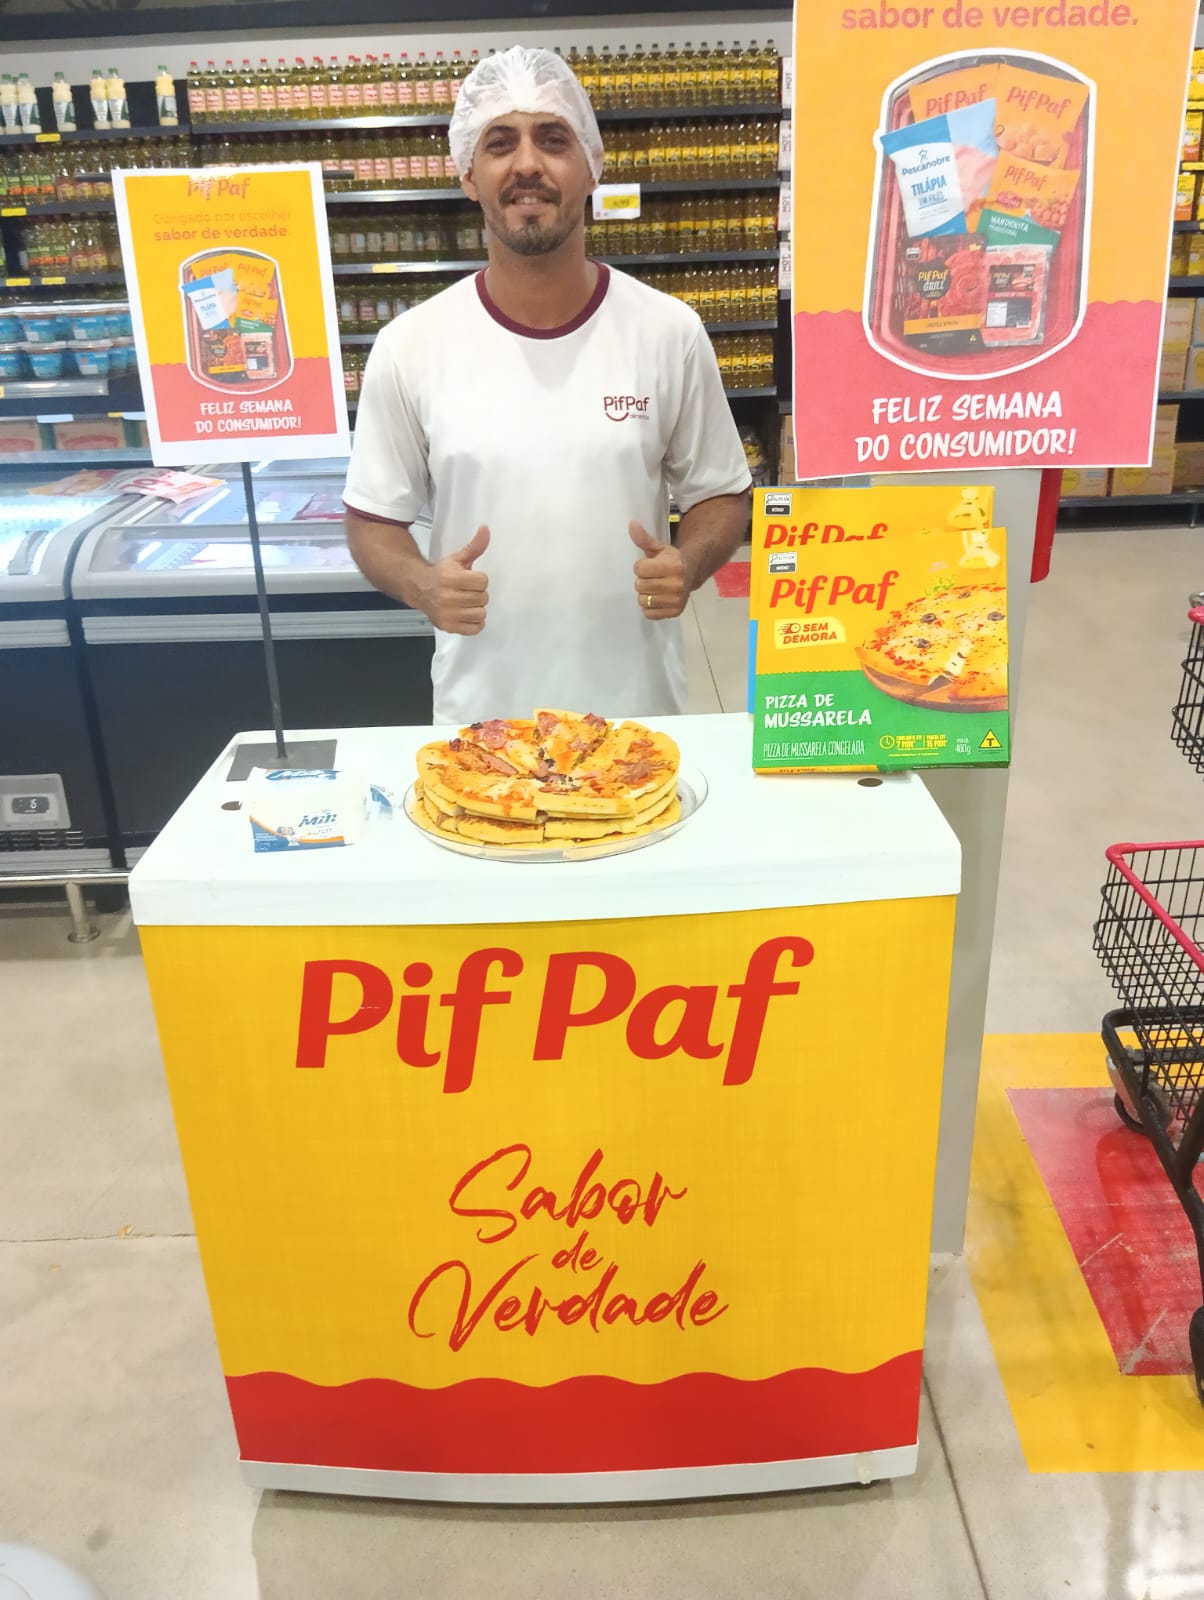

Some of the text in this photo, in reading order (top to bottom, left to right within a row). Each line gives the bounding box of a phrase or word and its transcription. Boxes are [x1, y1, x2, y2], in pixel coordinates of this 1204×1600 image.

[841, 0, 1139, 29] sabor de verdade.
[901, 155, 951, 176] Pescanobre
[911, 175, 948, 196] TILÁPIA
[154, 227, 198, 241] sabor
[201, 226, 221, 239] de
[200, 399, 293, 416] FELIZ SEMANA
[872, 391, 1063, 425] FELIZ SEMANA
[194, 416, 302, 434] DO CONSUMIDOR!
[855, 428, 1076, 462] DO CONSUMIDOR!
[803, 622, 829, 632] SEM
[783, 631, 837, 645] DEMORA
[765, 693, 835, 709] PIZZA DE
[764, 709, 872, 728] MUSSARELA
[763, 740, 865, 758] PIZZA DE MUSSARELA CONGELADA
[448, 1143, 688, 1244] Sabor
[551, 1229, 604, 1273] de
[408, 1254, 729, 1353] Verdade
